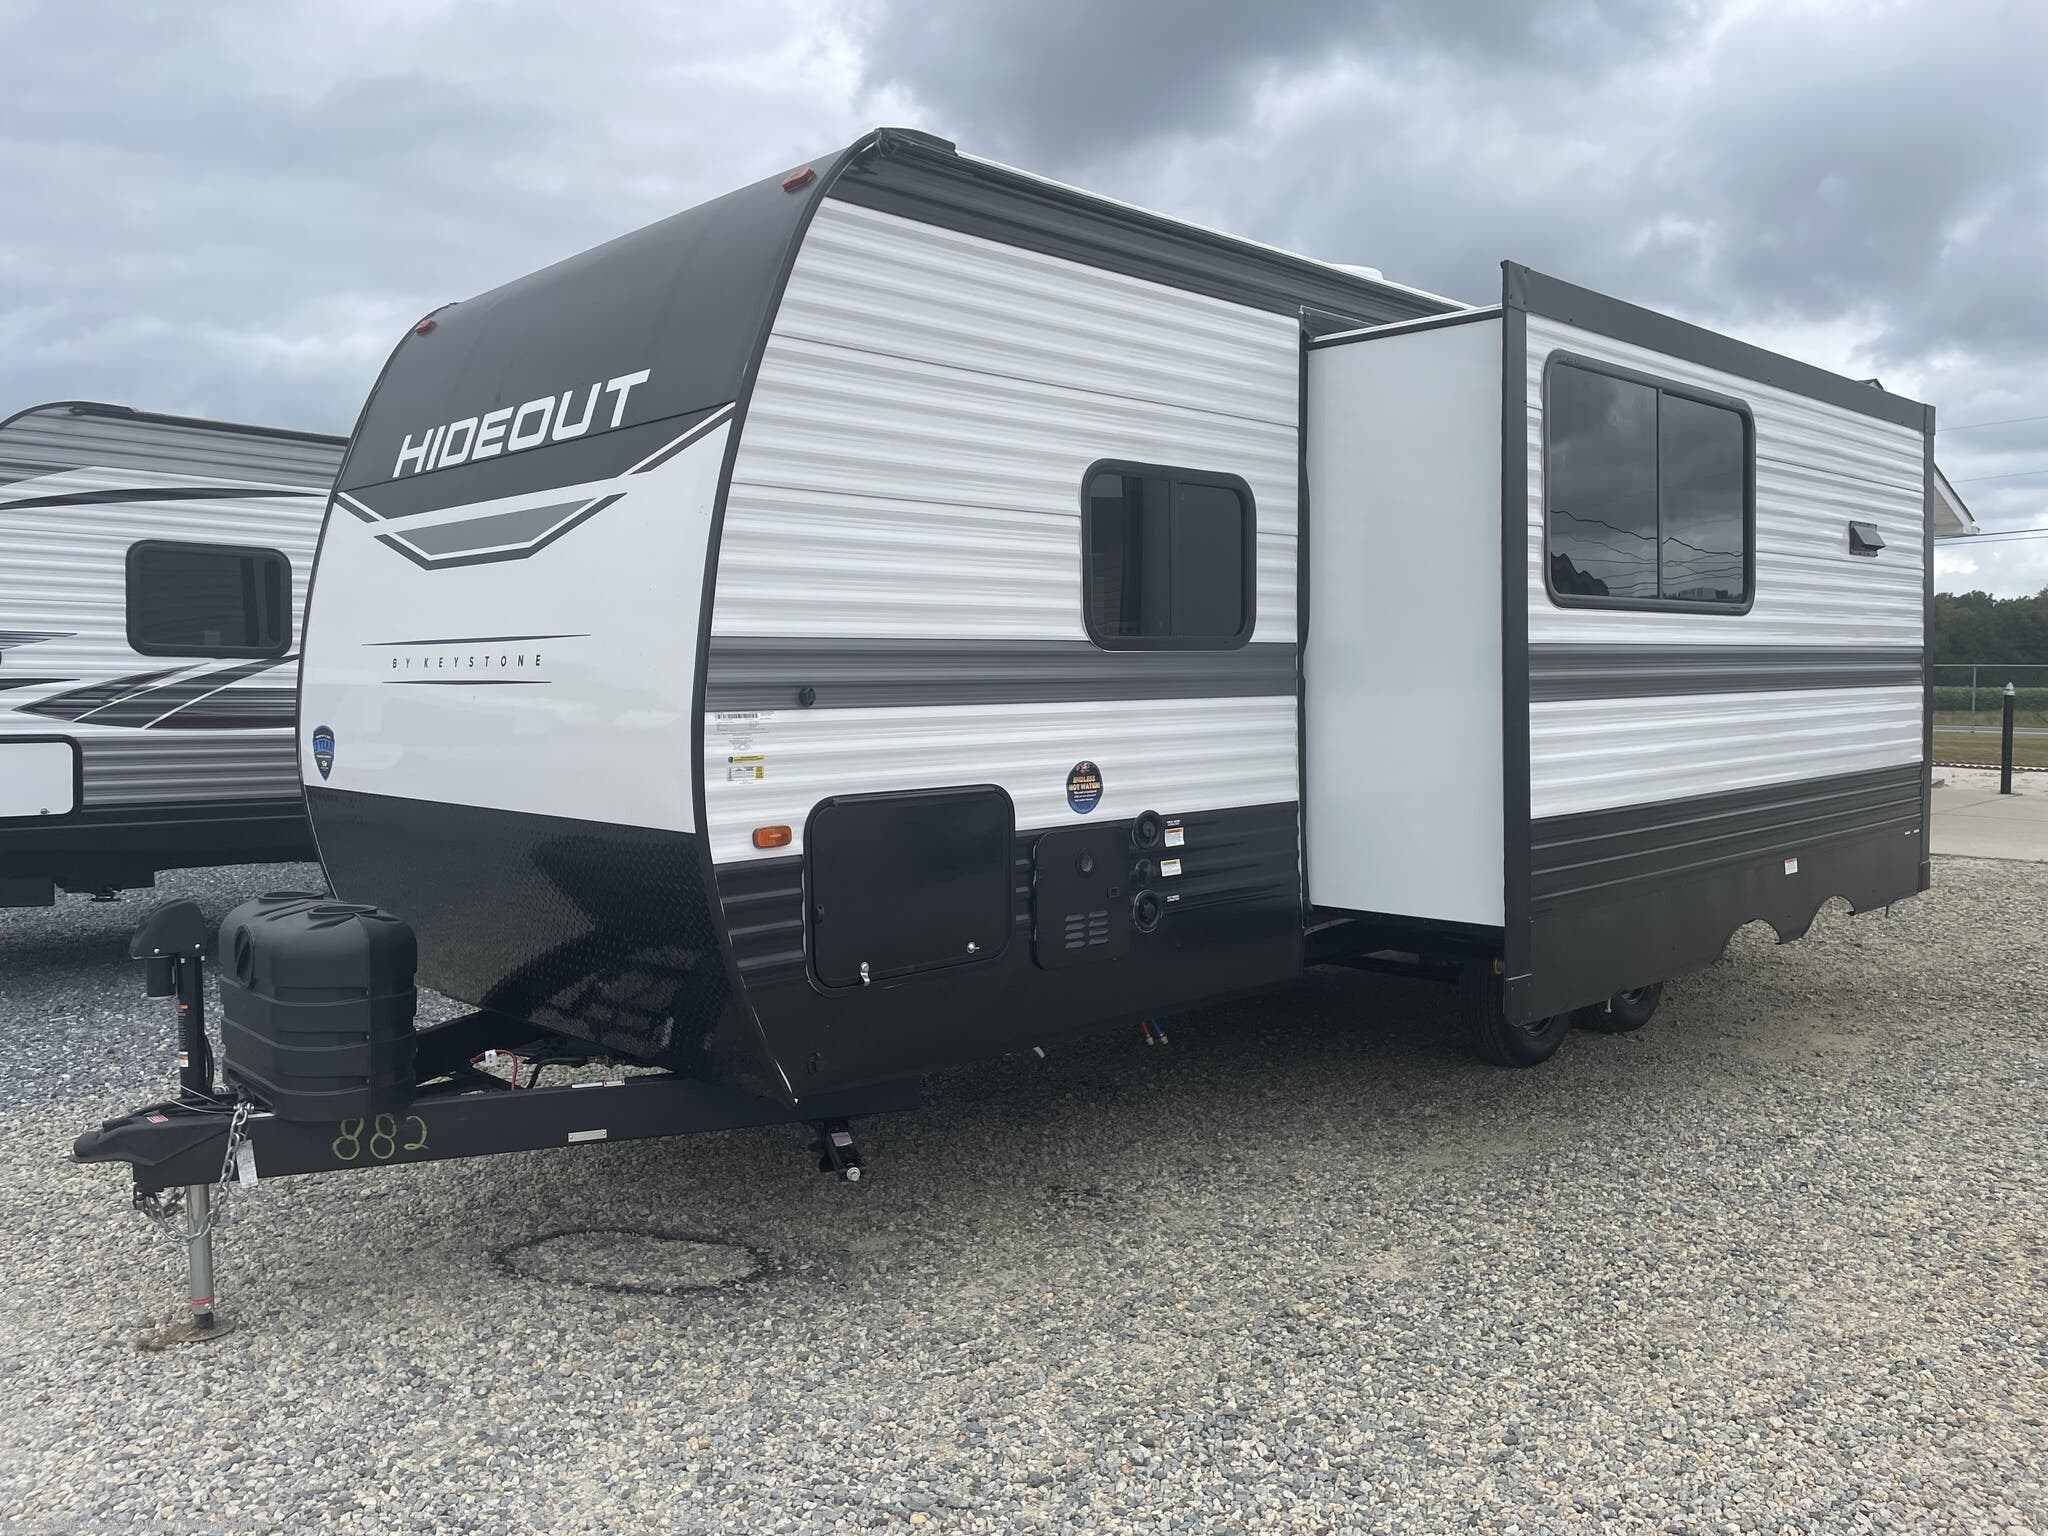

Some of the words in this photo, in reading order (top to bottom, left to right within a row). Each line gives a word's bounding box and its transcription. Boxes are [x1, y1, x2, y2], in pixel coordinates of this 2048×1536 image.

[392, 368, 651, 479] HIDEOUT
[392, 657, 410, 669] BY
[424, 654, 541, 669] KEYSTONE
[1068, 783, 1080, 792] HOT
[332, 1112, 430, 1161] 882
